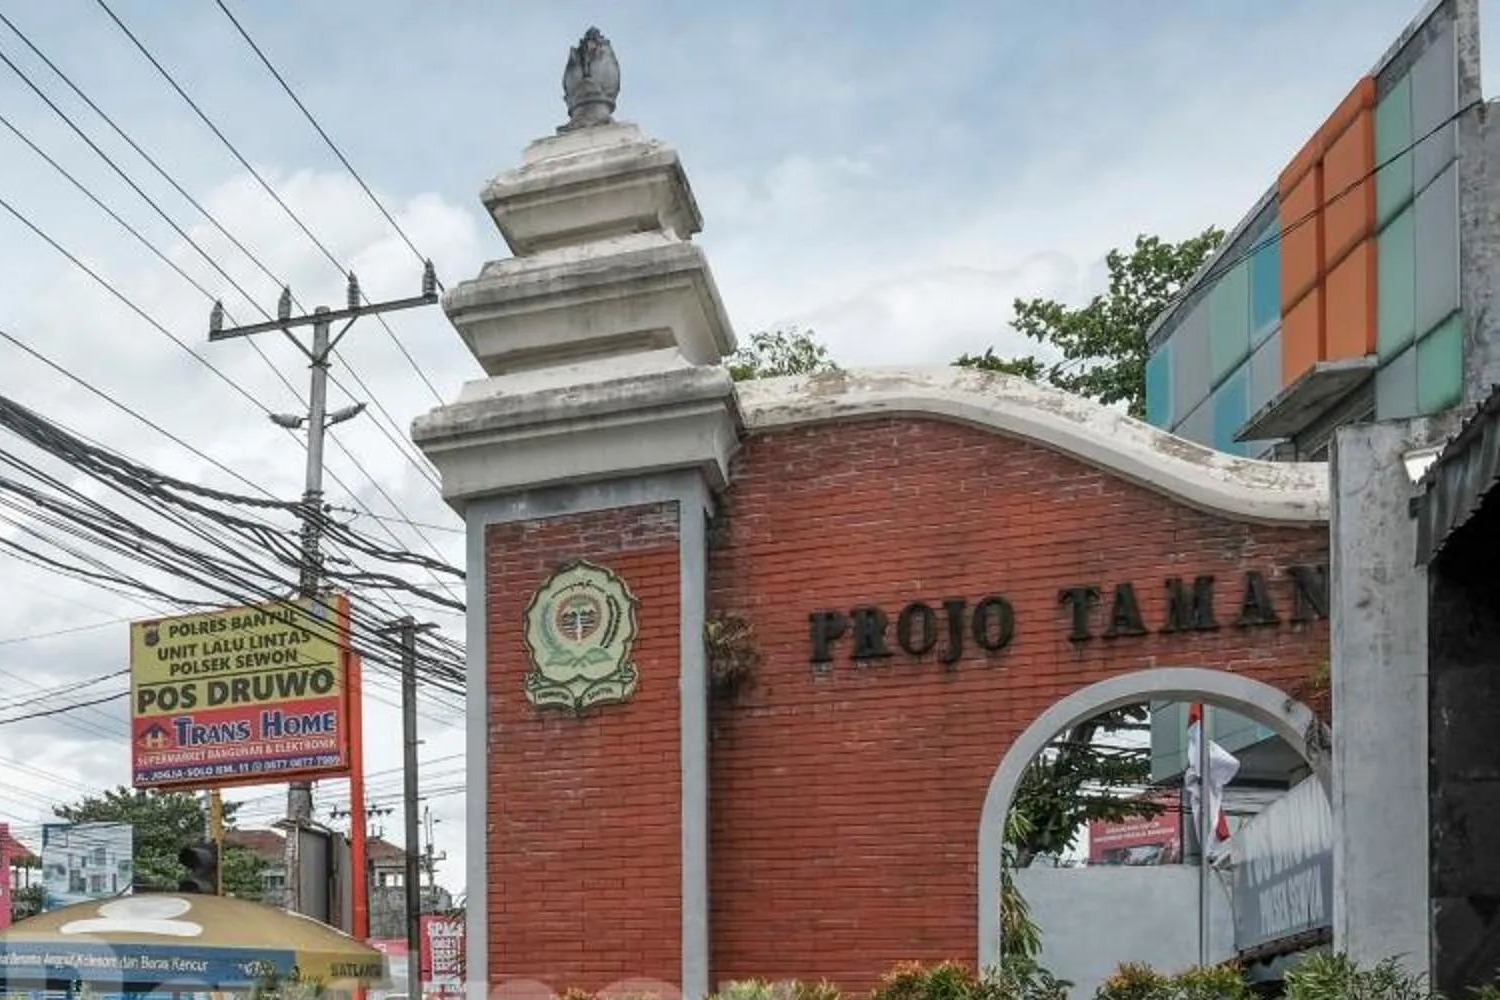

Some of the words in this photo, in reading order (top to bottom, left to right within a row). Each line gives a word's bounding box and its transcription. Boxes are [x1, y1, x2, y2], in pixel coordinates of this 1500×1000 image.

[169, 616, 227, 639] POLRES
[808, 594, 1016, 664] PROJO
[1058, 564, 1331, 643] TAMAN
[157, 643, 197, 661] UNIT
[203, 638, 245, 656] LALU
[250, 630, 312, 648] LINTAS
[170, 656, 232, 676] POLSEK
[235, 648, 298, 669] SEWON
[137, 683, 198, 713] POS
[207, 668, 335, 707] DRUWO
[137, 749, 206, 767] SUPERMARKET
[275, 738, 337, 754] ELEKTRONIK
